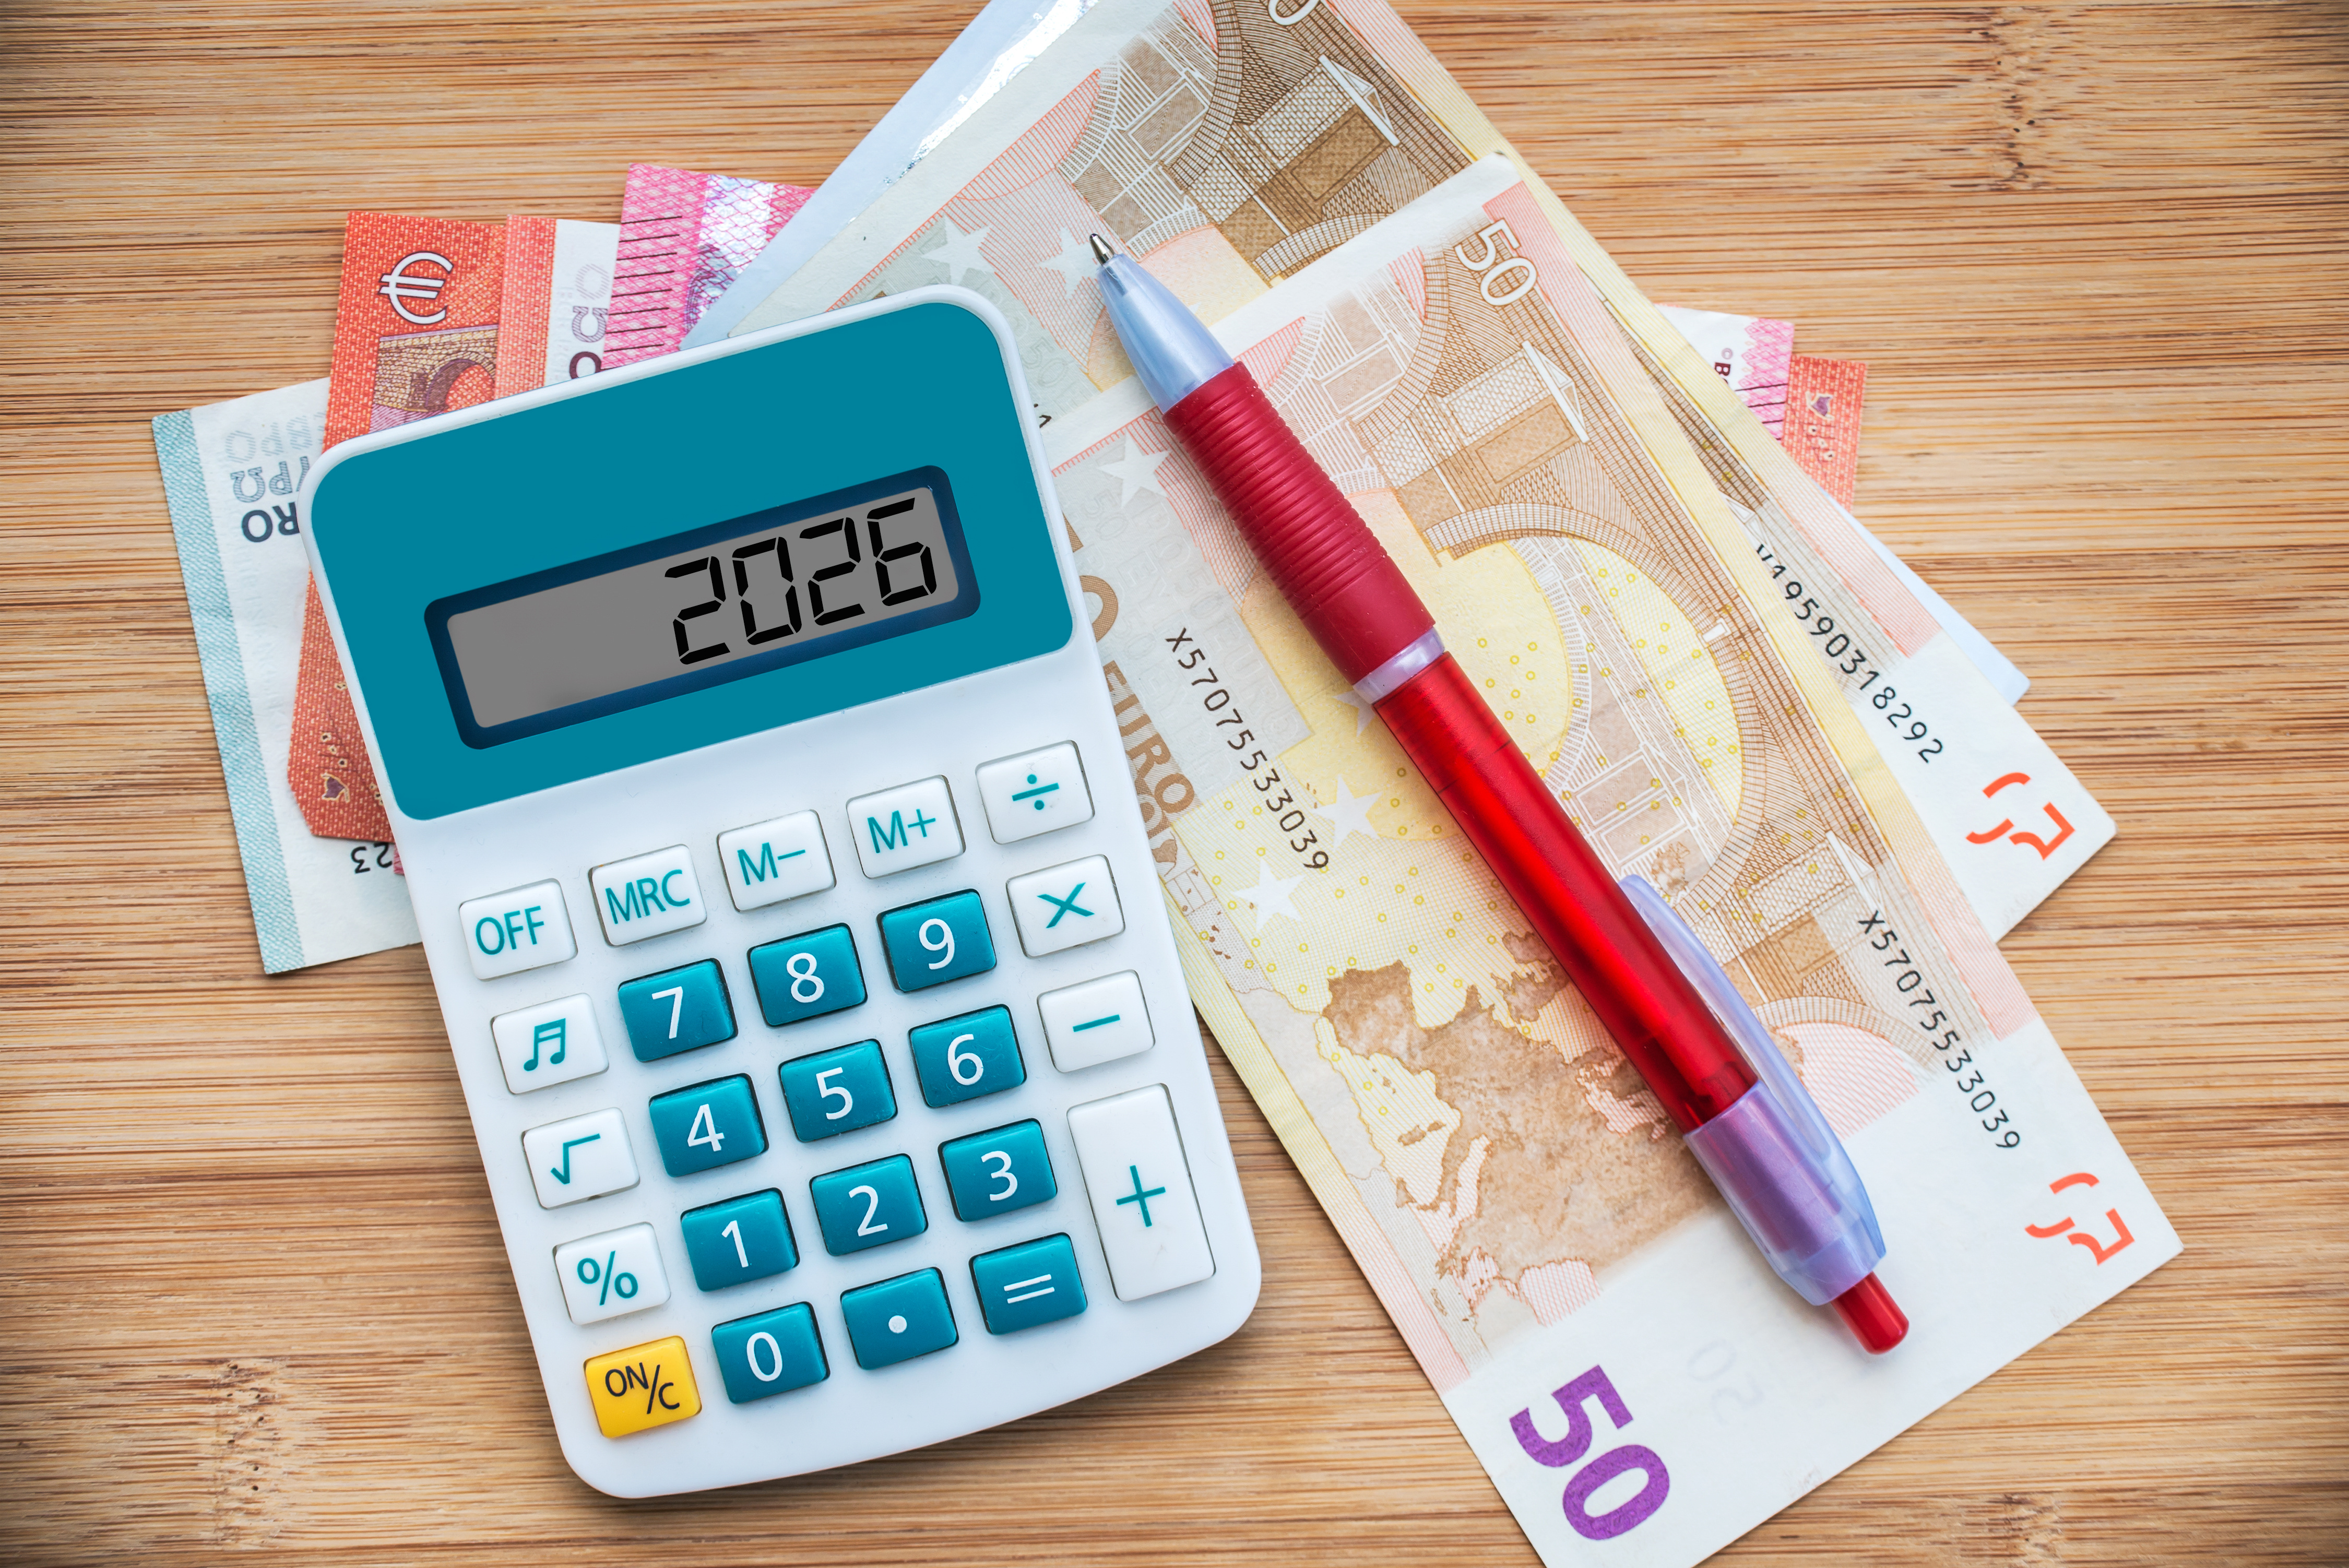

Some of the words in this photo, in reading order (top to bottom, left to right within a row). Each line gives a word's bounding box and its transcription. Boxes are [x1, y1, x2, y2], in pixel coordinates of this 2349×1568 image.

[1454, 218, 1538, 306] 50
[665, 497, 937, 665] 2026
[1166, 627, 1329, 869] X57075533039
[867, 809, 936, 854] M+
[605, 869, 691, 924] MRC
[476, 906, 544, 955] OFF
[919, 918, 955, 970] 9
[786, 953, 824, 1003] 8
[651, 986, 683, 1039] 7
[1858, 910, 2021, 1149] X57075533039
[947, 1034, 983, 1085] 6
[816, 1067, 852, 1120] 5
[687, 1103, 724, 1151] 4
[981, 1150, 1017, 1201] 3
[848, 1185, 888, 1237] 2
[721, 1220, 749, 1267] 1
[746, 1332, 782, 1382] 0
[605, 1362, 680, 1415] ON/C
[1509, 1364, 1670, 1540] 50
